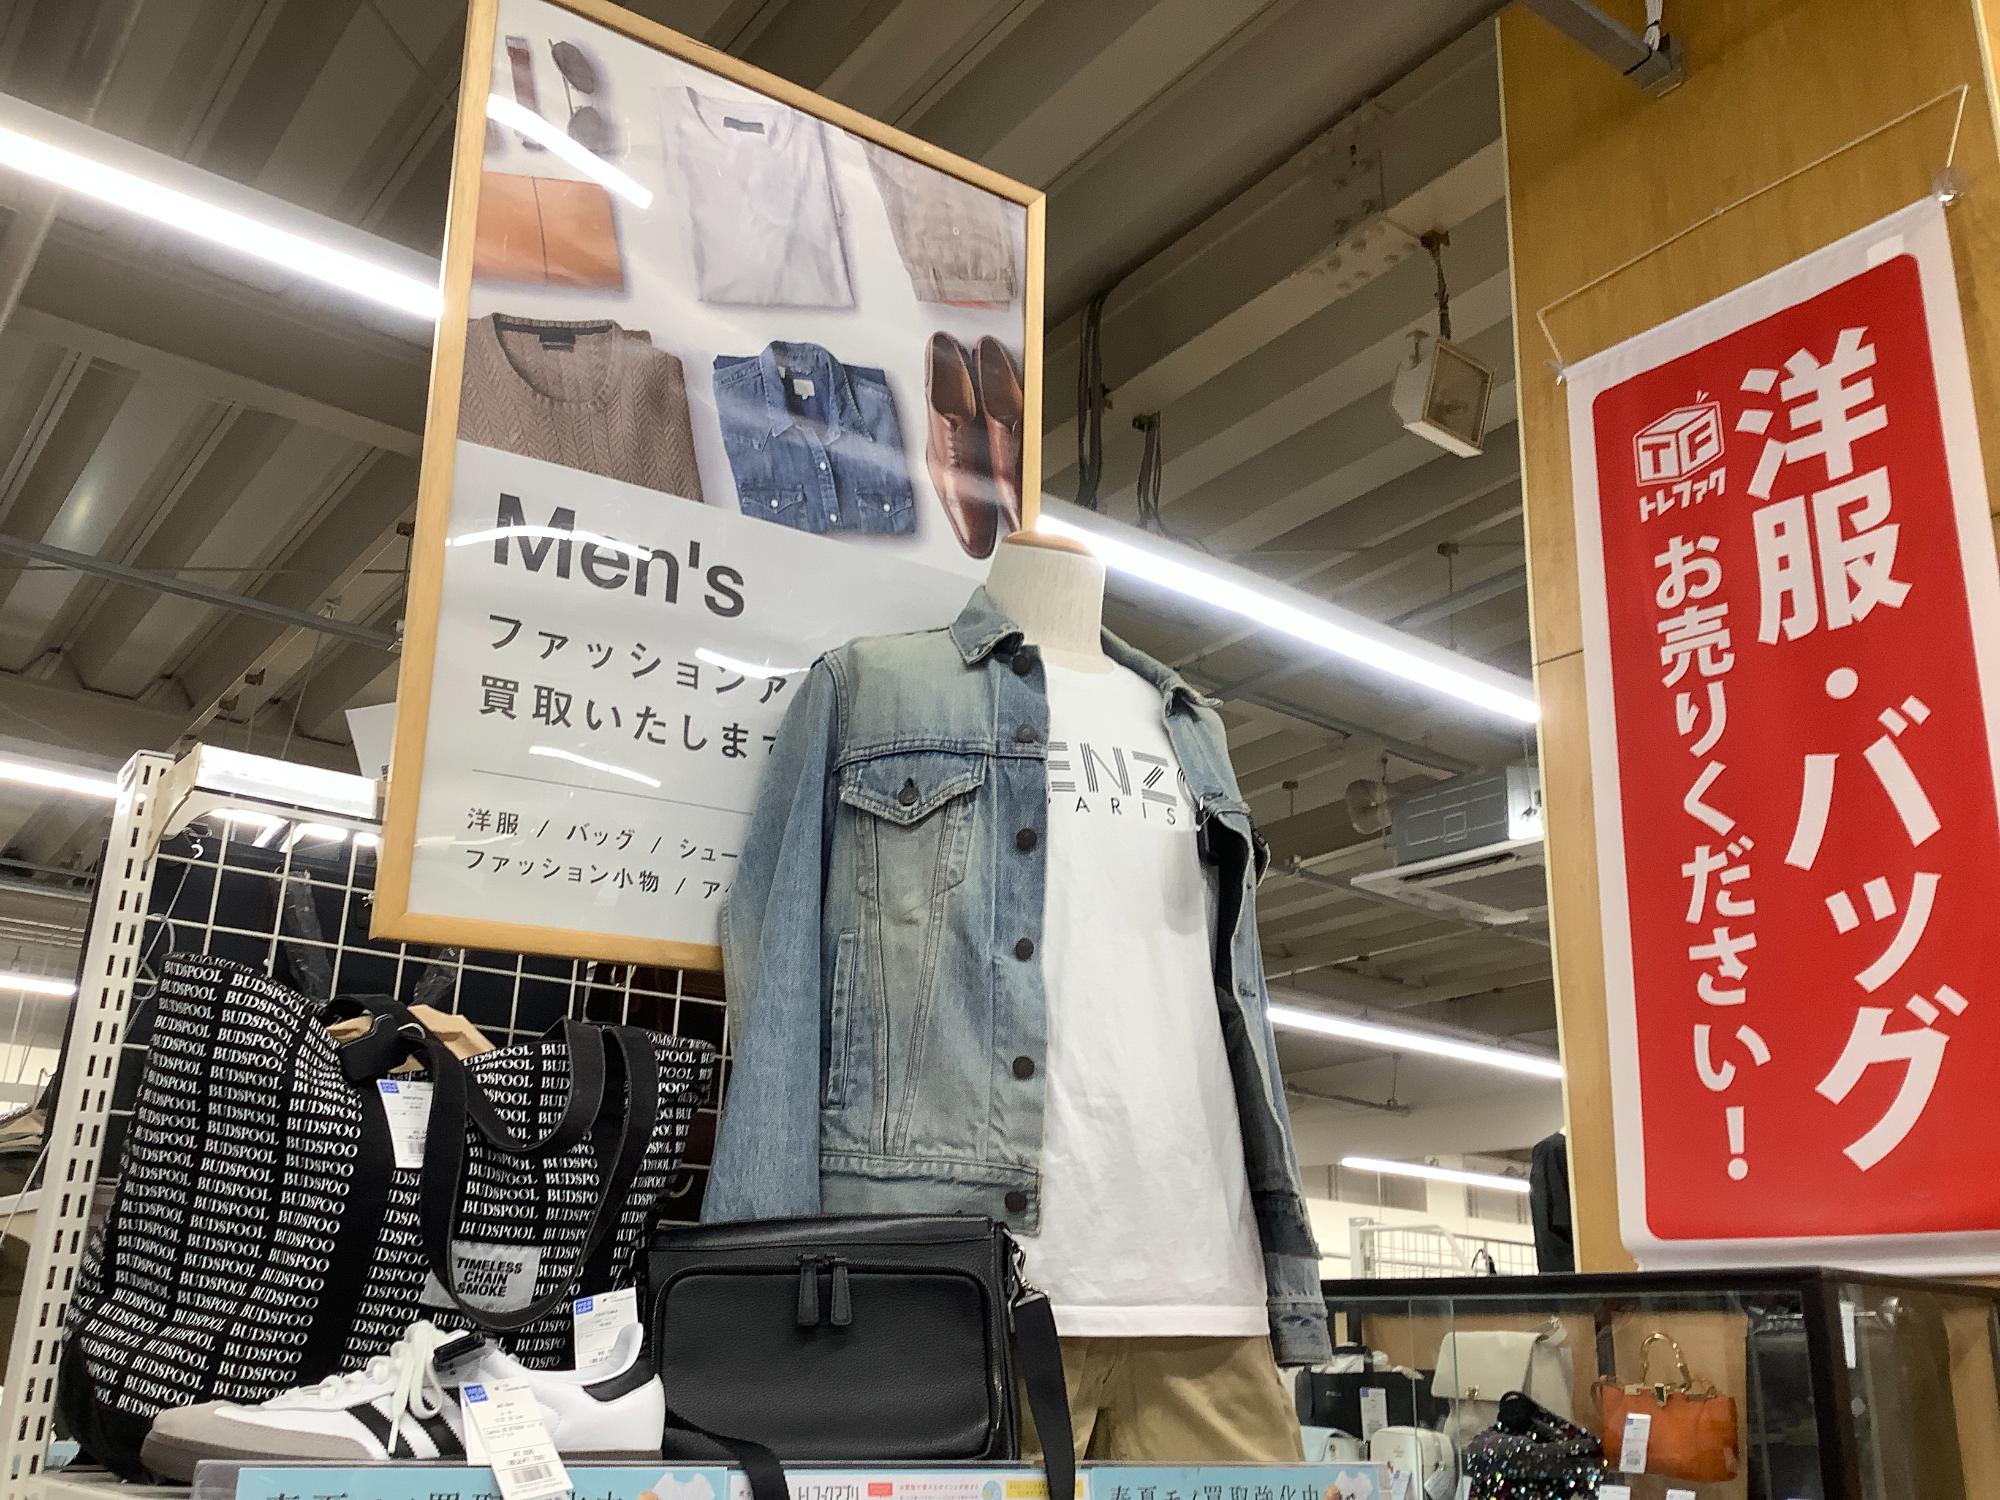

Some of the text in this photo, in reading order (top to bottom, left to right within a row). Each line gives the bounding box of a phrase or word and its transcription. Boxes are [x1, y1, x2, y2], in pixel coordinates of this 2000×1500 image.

[1638, 467, 1726, 523] トレファク
[493, 492, 745, 618] Men's
[1735, 326, 1969, 1172] 洋服・バッグ
[1048, 742, 1195, 808] ENZ
[1048, 796, 1176, 825] ARIS
[466, 807, 519, 836] 洋服
[566, 823, 636, 852] バッグ
[680, 838, 738, 861] シュー
[1653, 535, 1771, 1180] お売りください！
[465, 848, 659, 893] ファッション小物
[702, 880, 733, 899] ア
[164, 961, 223, 983] BUDSPOOL
[230, 973, 305, 1019] BUDSPOOL
[224, 990, 300, 1033] BUDSPOOL
[154, 1015, 210, 1038] BUDSPOOL
[216, 1027, 288, 1061] BUDSPOOL
[221, 1009, 293, 1047] BUDSPOOL
[212, 1046, 286, 1074] BUDSPOOL
[210, 1065, 283, 1090] BUDSPOOL
[209, 1084, 280, 1109] BUDSPOOL
[209, 1102, 279, 1127] BUDSPOOL
[207, 1120, 279, 1145] BUDSPOOL
[204, 1139, 276, 1164] BUDSPOOL
[200, 1158, 274, 1183] BUDSPOOL
[468, 1162, 537, 1184] BUDSPOOL
[197, 1177, 272, 1201] BUDSPOOL
[466, 1181, 539, 1200] BUDSPOOL
[194, 1195, 269, 1220] BUDSPOOL
[463, 1200, 538, 1219] BUDSPOOL
[190, 1214, 266, 1239] BUDSPOOL
[459, 1221, 535, 1239] BUDSPOOL
[118, 1235, 177, 1261] BUDSPOOL
[183, 1252, 255, 1278] BUDSPOOL
[187, 1233, 262, 1258] BUDSPOOL
[457, 1256, 523, 1274] TIMELESS
[464, 1271, 508, 1285] CHAIN
[179, 1271, 248, 1297] BUDSPOOL
[457, 1282, 507, 1297] SMOKE
[112, 1288, 167, 1318] BUDSPOOL
[172, 1309, 227, 1331] BUDSPOOL
[176, 1290, 238, 1316] BUDSPOOL
[97, 1302, 158, 1334] BUDSPOOL
[85, 1318, 143, 1348] BUDSPOOL
[143, 1339, 210, 1371] BUDSPOOL
[131, 1355, 204, 1390] BUDSPOOL
